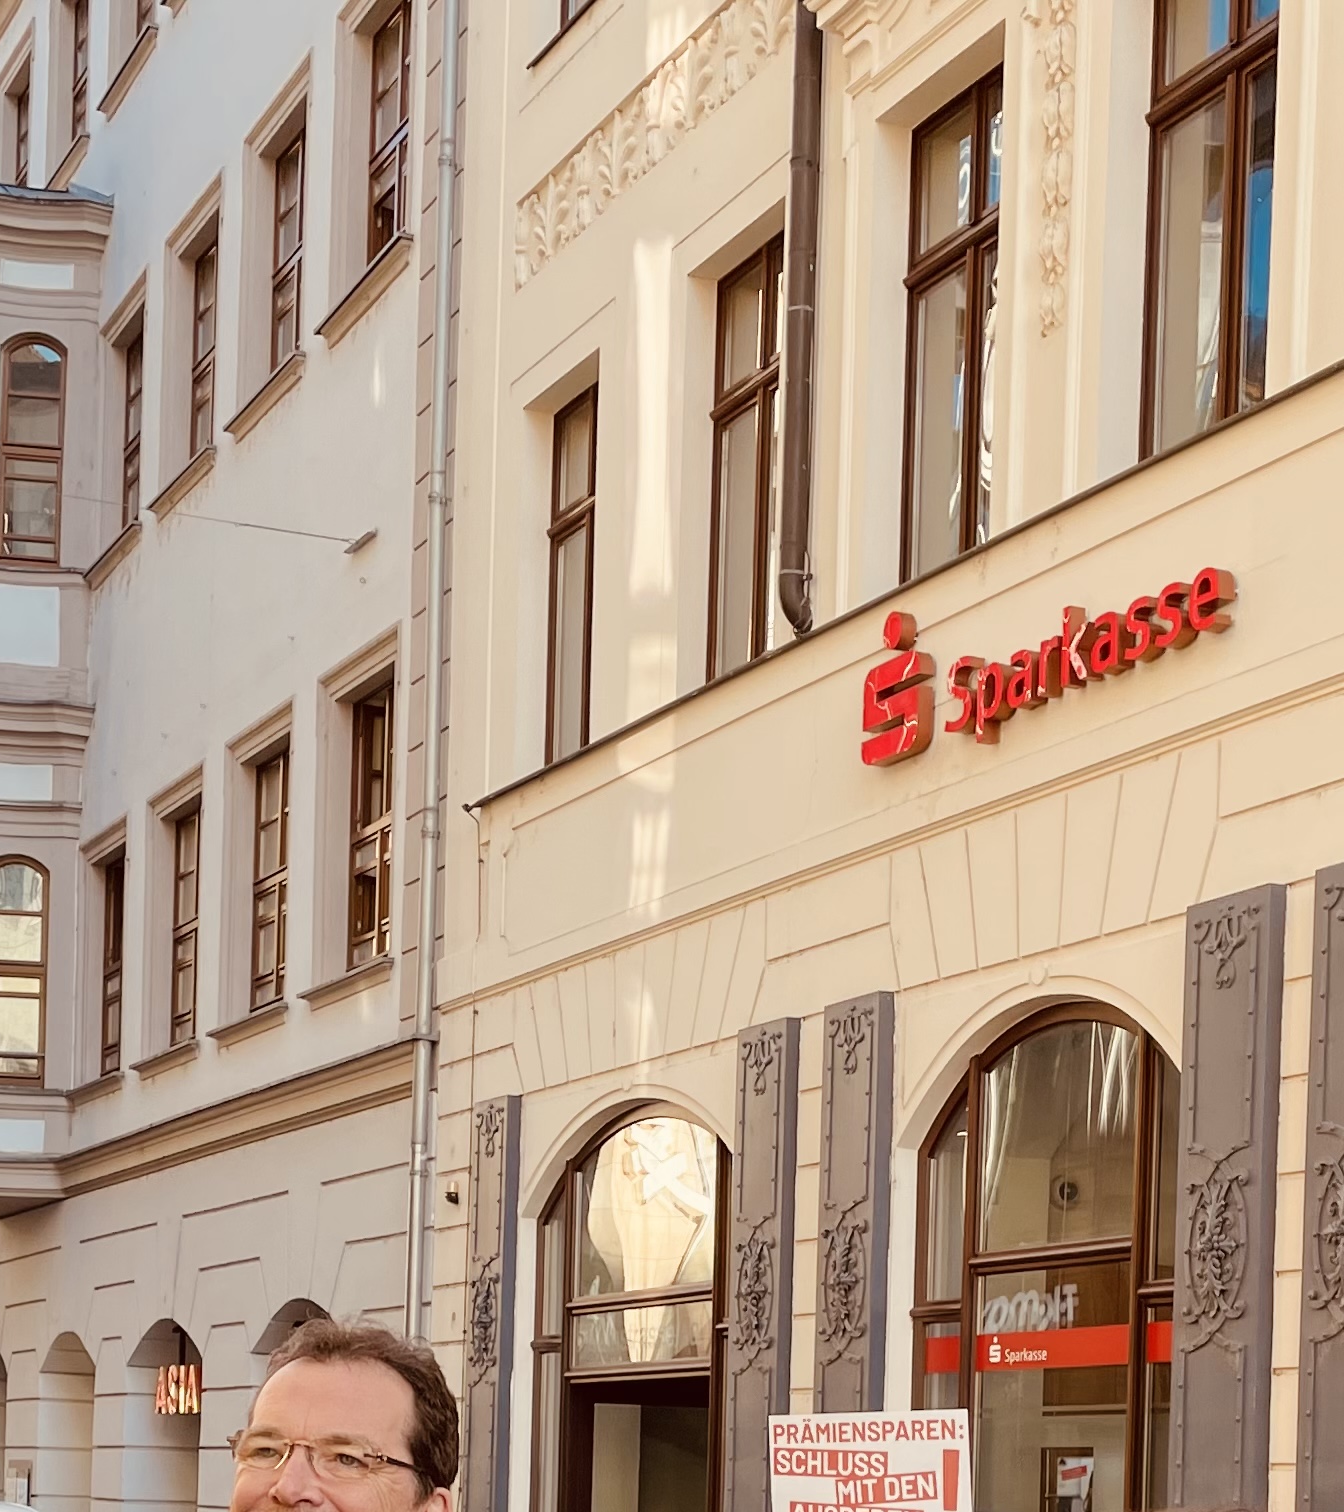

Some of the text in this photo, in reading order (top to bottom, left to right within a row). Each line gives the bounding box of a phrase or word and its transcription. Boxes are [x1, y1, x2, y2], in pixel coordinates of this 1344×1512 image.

[945, 566, 1238, 744] Sparkasse
[1004, 1348, 1047, 1365] Sparkasse
[155, 1364, 201, 1415] ASIA
[773, 1418, 965, 1445] PRÄMIENSPAREN:
[776, 1450, 886, 1477] SCHLUSS
[838, 1473, 935, 1505] MIT DEN
